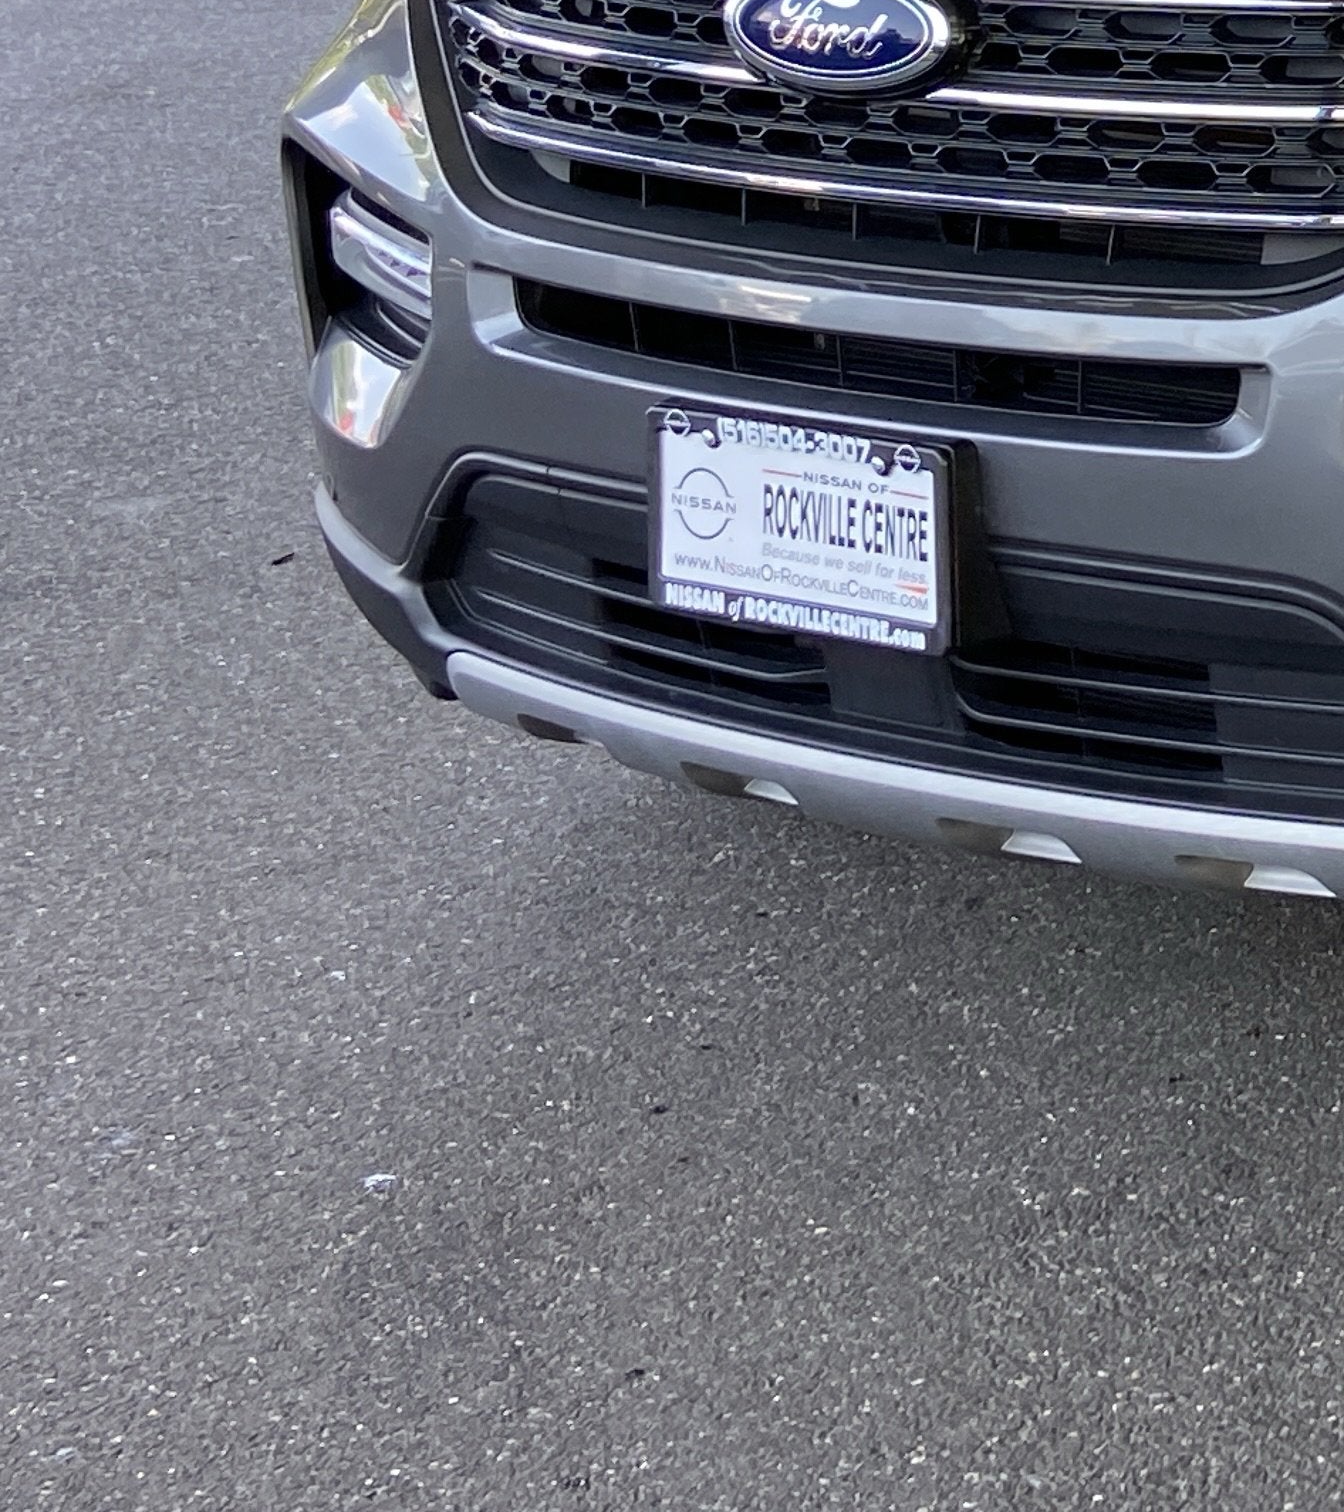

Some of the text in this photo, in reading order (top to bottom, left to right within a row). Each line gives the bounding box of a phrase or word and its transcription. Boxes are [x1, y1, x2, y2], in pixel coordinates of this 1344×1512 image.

[803, 472, 890, 495] NISSAN OF
[671, 492, 737, 514] NISSAN
[762, 483, 929, 563] ROCKVILLE CENTRE
[761, 542, 820, 566] Because
[824, 556, 844, 570] we
[847, 559, 872, 575] sell
[874, 562, 895, 578] for
[664, 582, 726, 615] NISSAN
[728, 595, 745, 622] of
